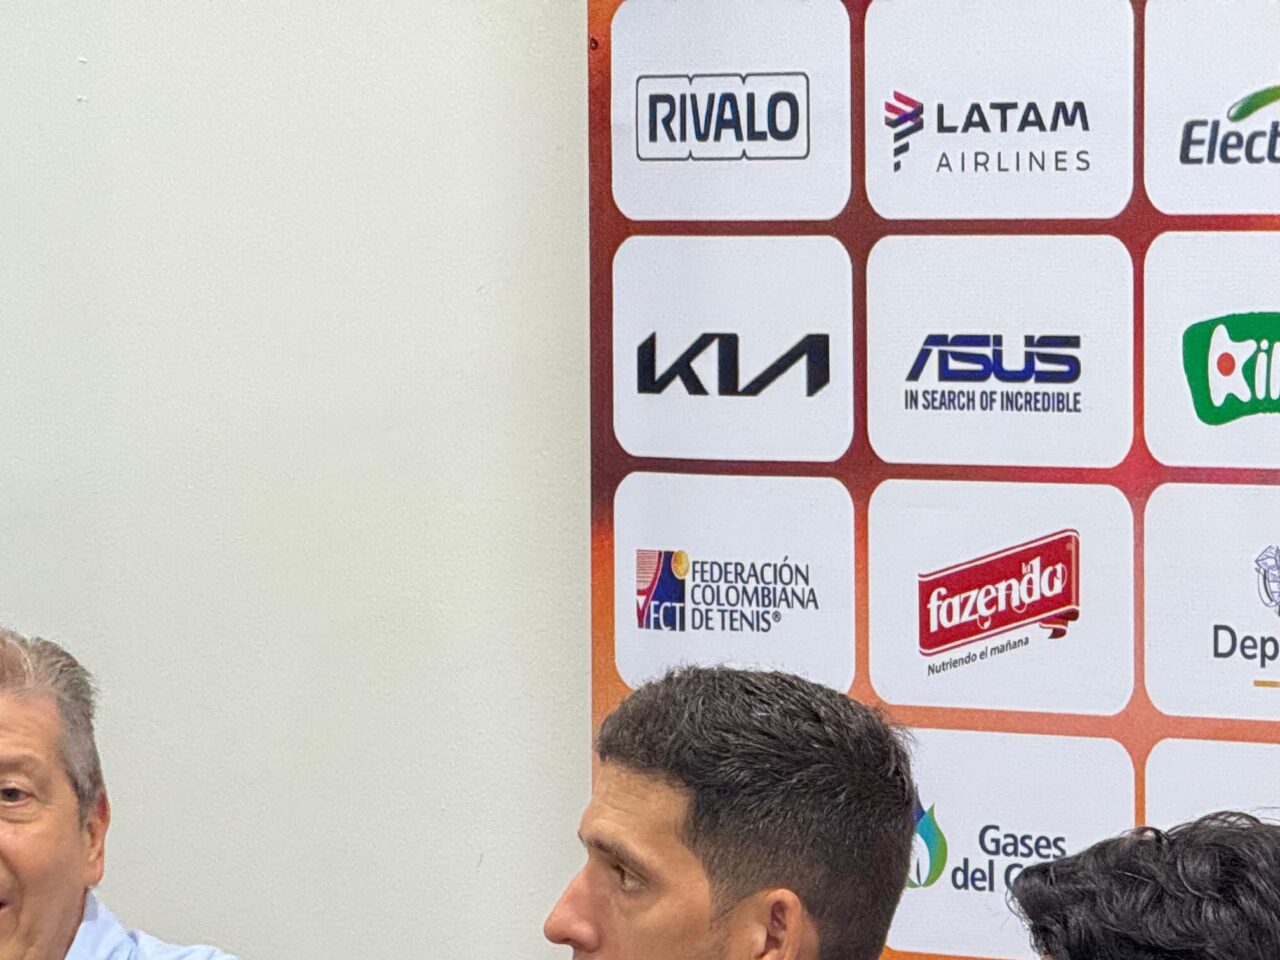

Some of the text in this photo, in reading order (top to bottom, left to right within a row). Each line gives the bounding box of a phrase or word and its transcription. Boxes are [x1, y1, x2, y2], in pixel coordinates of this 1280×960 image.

[648, 91, 801, 144] RIVALO
[936, 100, 1091, 134] LATAM
[936, 150, 1091, 173] AIRLINES
[637, 332, 830, 397] KIA
[905, 334, 1081, 384] ASUS
[904, 389, 1082, 413] IN SEARCH OF INCREDIBLE
[691, 555, 810, 587] FEDERACIÓN
[690, 583, 820, 610] COLOMBIANA
[926, 556, 1067, 633] fazenda
[691, 607, 714, 631] DE
[927, 636, 1030, 677] Nutriendo el mañana
[1213, 624, 1280, 669] Dep
[978, 824, 1067, 859] Gases
[951, 857, 995, 892] del
